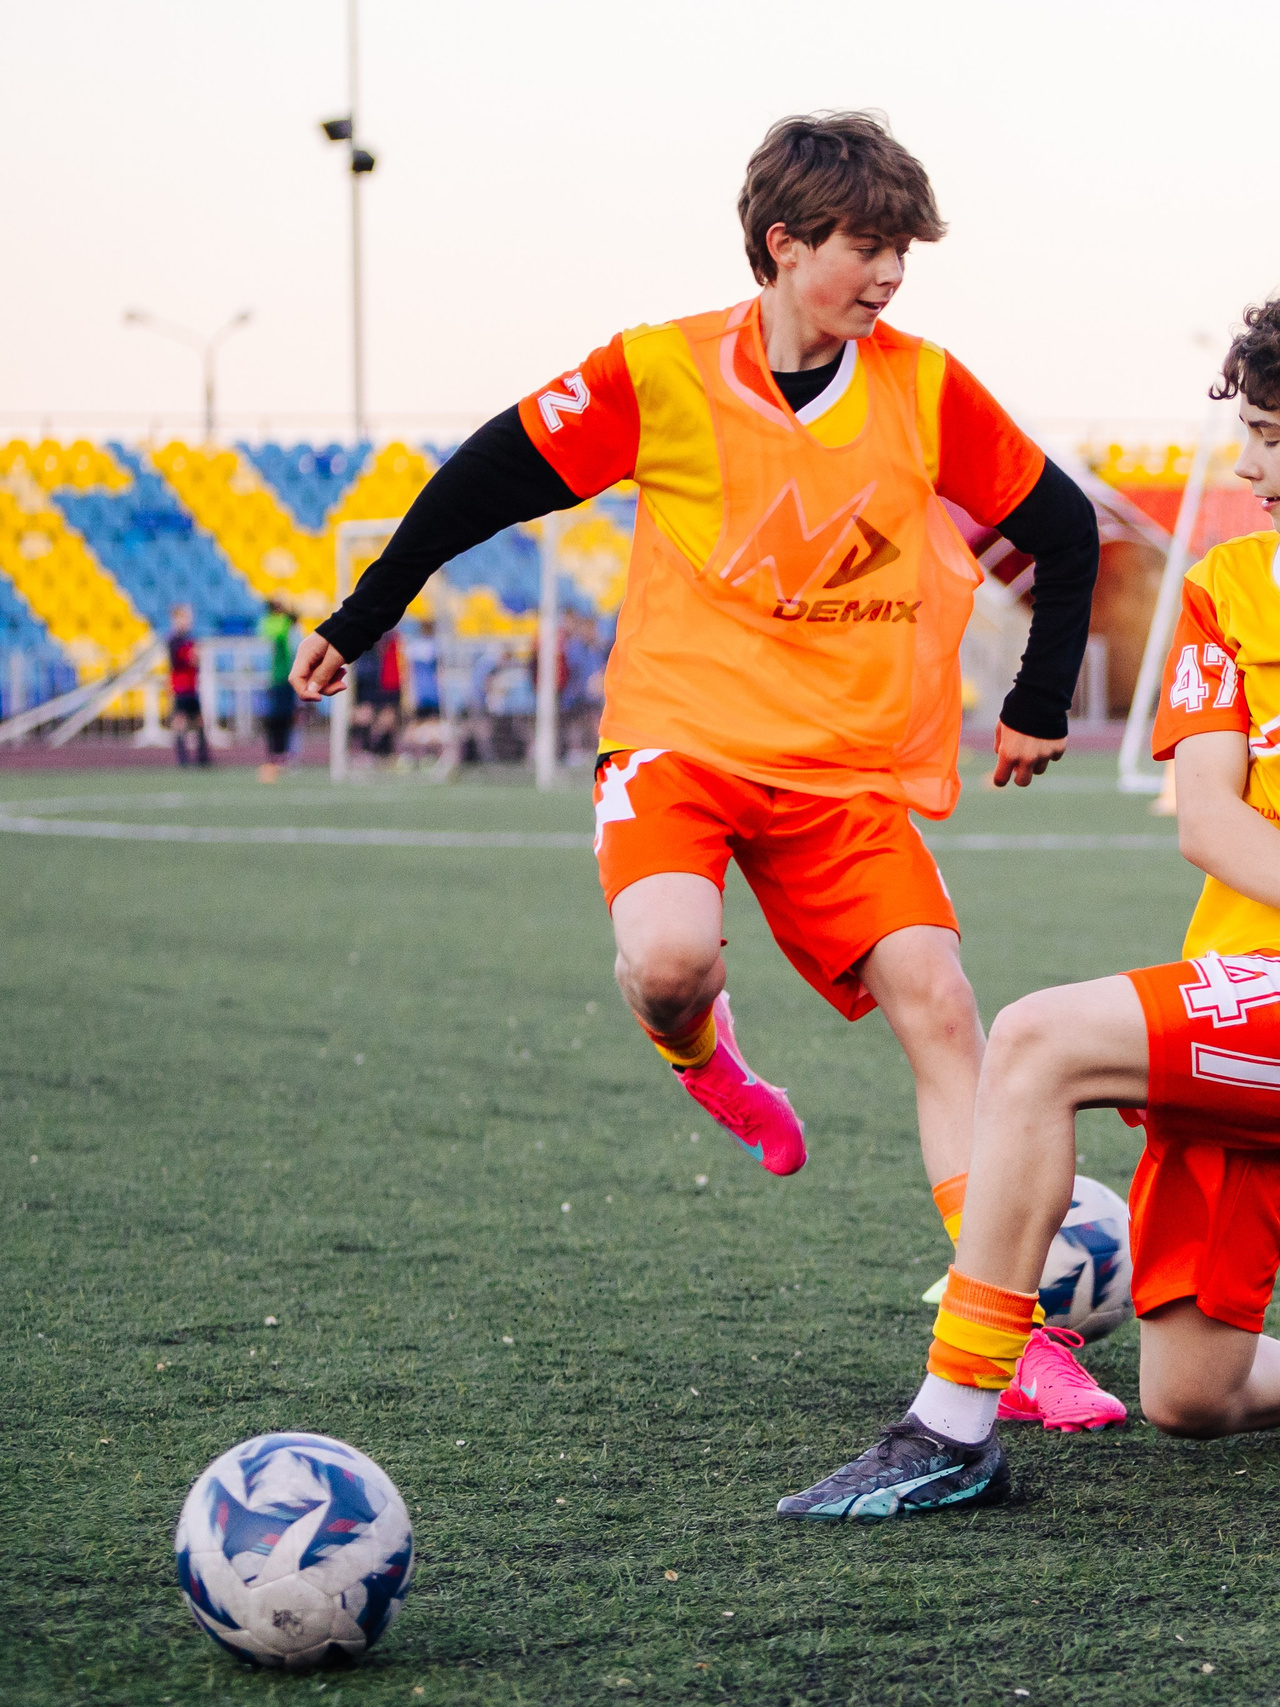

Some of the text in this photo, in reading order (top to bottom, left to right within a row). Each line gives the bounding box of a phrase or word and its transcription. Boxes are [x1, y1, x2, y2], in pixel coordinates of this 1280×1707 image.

[537, 372, 591, 434] 2
[772, 598, 923, 624] DEMIX
[1169, 643, 1239, 713] 47
